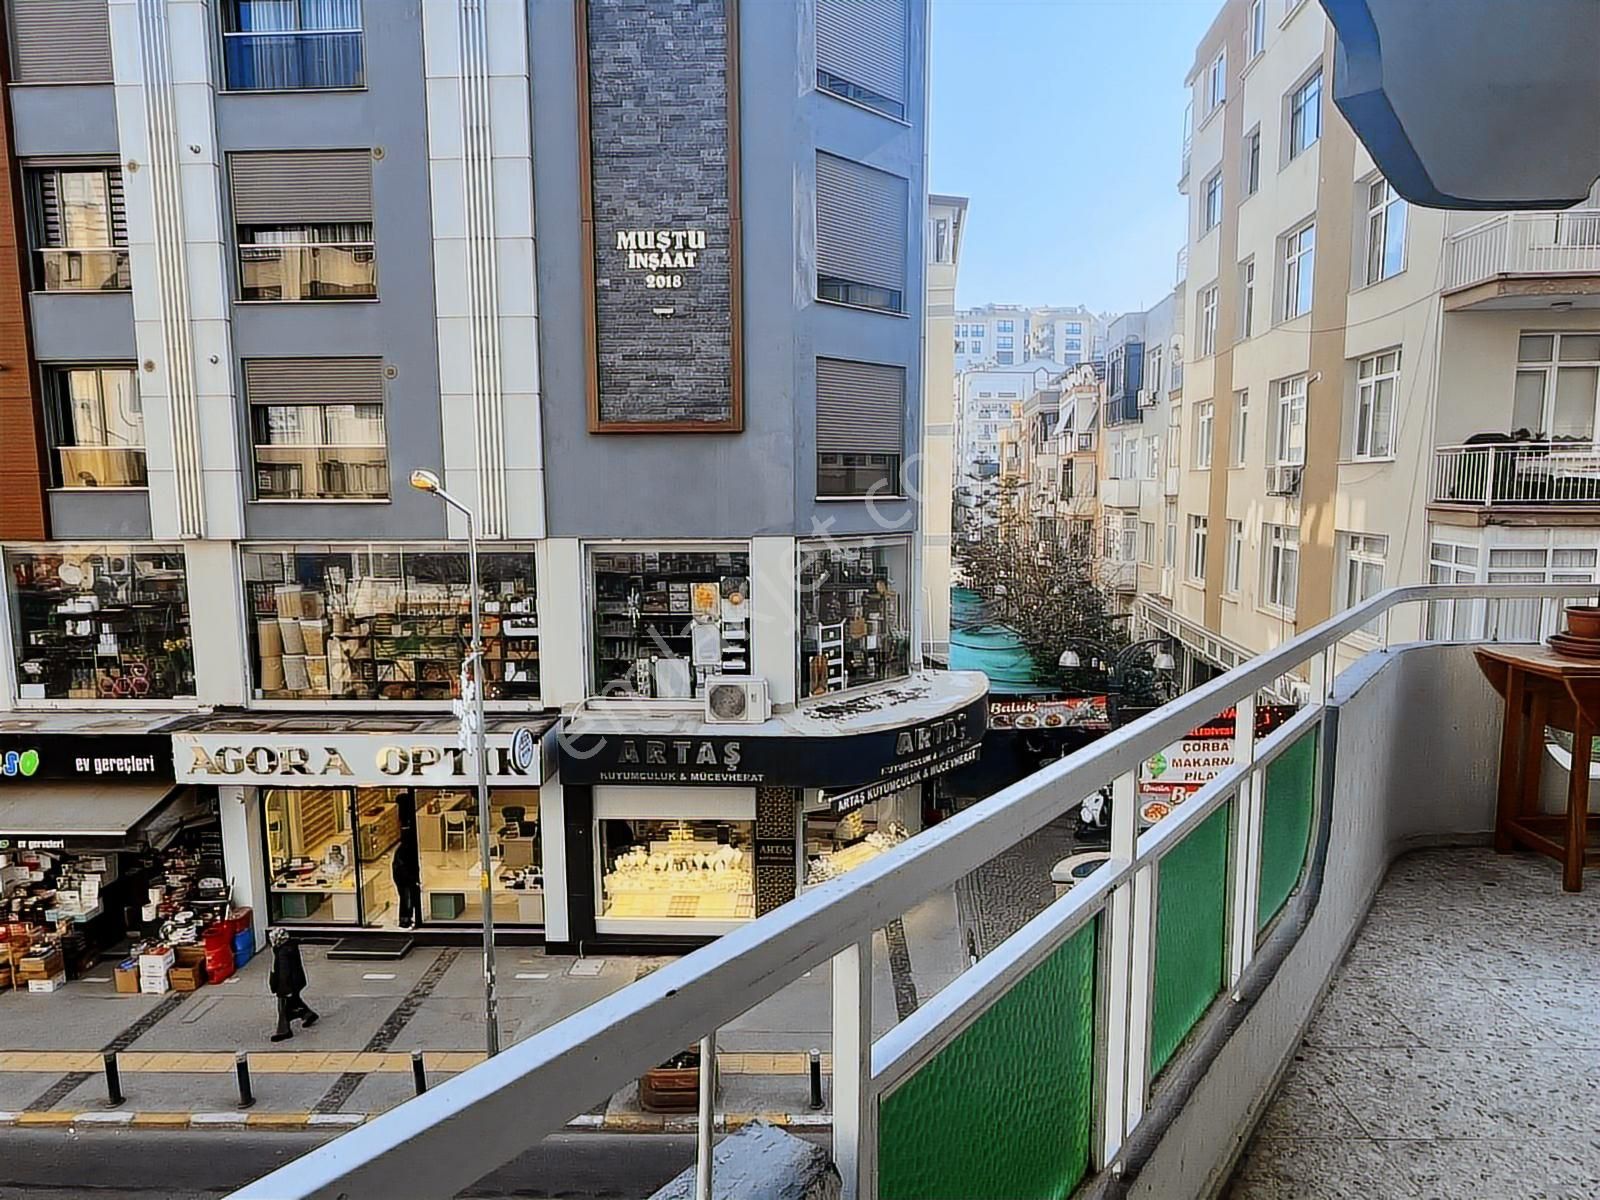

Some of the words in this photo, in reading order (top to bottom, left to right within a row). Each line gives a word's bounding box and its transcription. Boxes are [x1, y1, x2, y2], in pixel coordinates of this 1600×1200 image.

[616, 230, 706, 253] MUŞTU
[628, 250, 697, 271] İNŞAAT
[646, 275, 682, 289] 2018
[618, 740, 742, 771] ARTAŞ
[1182, 742, 1230, 754] ÇORBA
[0, 749, 39, 776] SO
[76, 757, 90, 772] ev
[94, 755, 155, 774] gereçleri
[187, 746, 355, 775] AGORA
[600, 772, 676, 781] KUYUMCULUK
[680, 772, 687, 781] &
[690, 772, 765, 782] MÜCEVHERAT
[1184, 771, 1218, 781] PİLA
